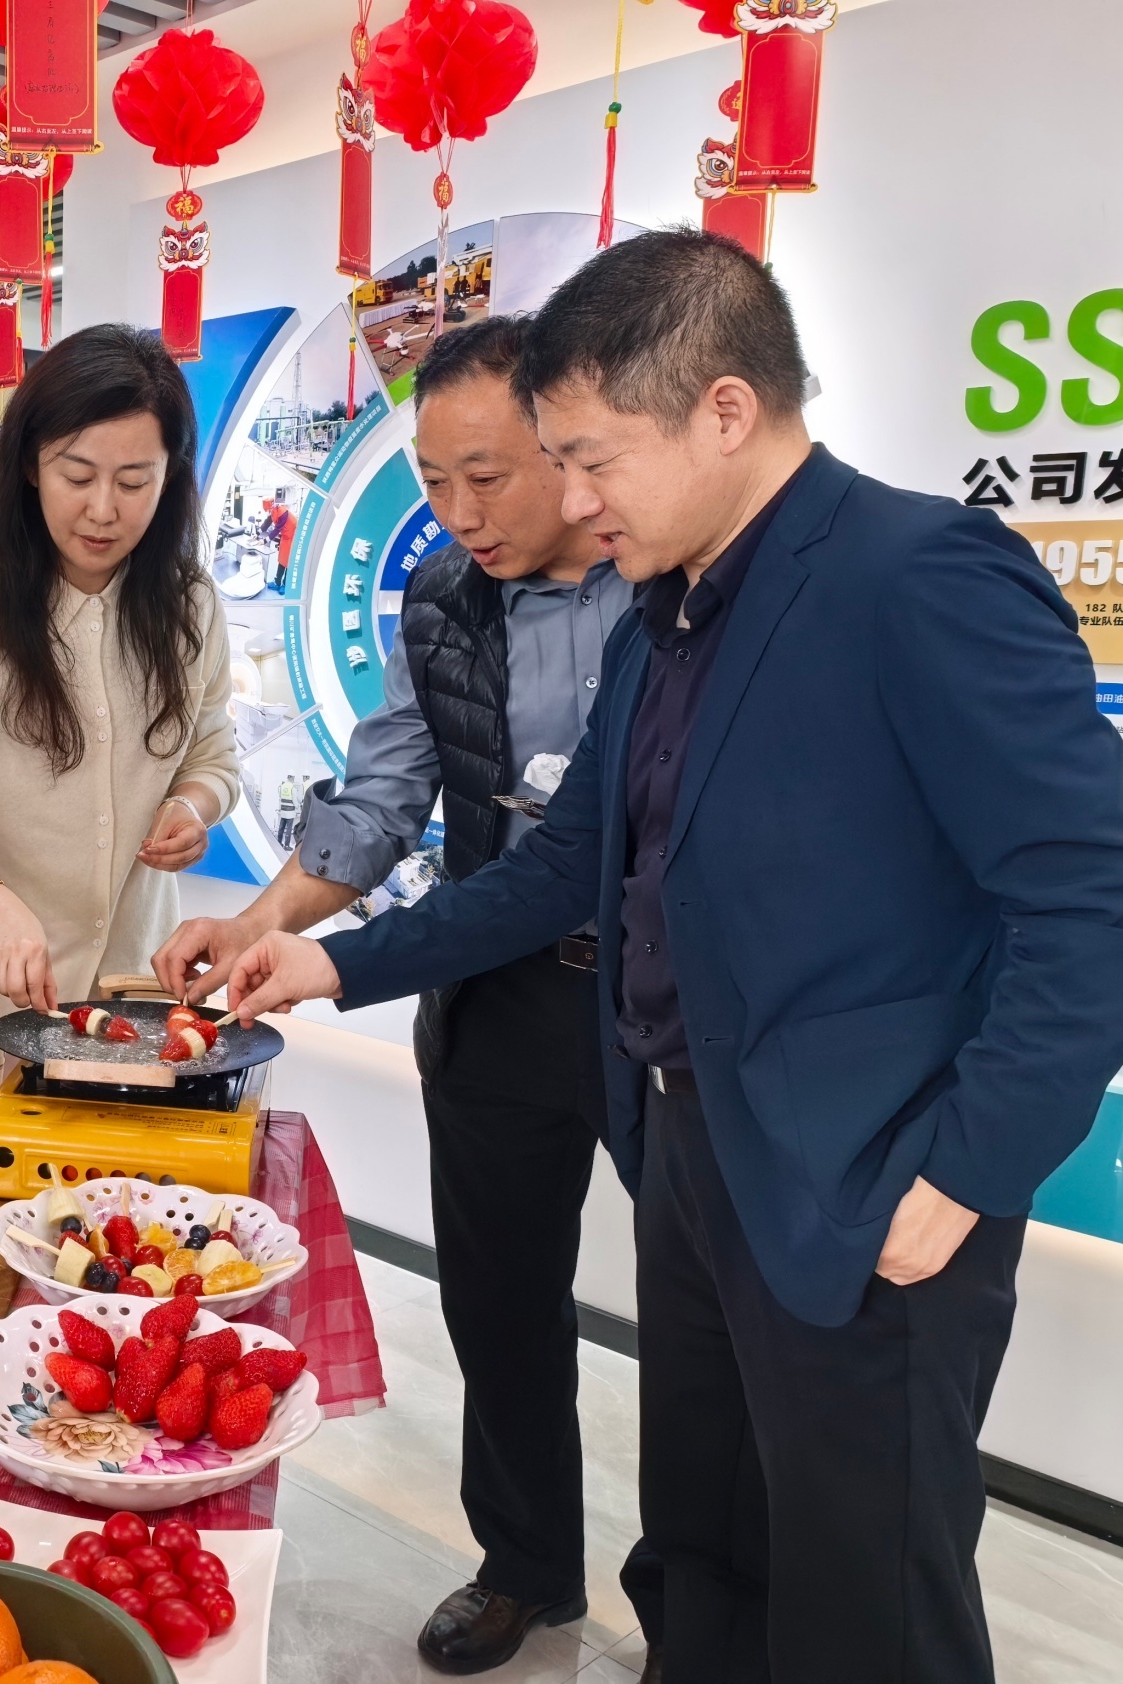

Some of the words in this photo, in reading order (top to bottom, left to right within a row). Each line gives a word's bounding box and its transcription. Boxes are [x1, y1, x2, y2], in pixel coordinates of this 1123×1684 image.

[175, 196, 194, 215] 福
[400, 520, 445, 573] 地质勘
[1085, 603, 1107, 613] 182
